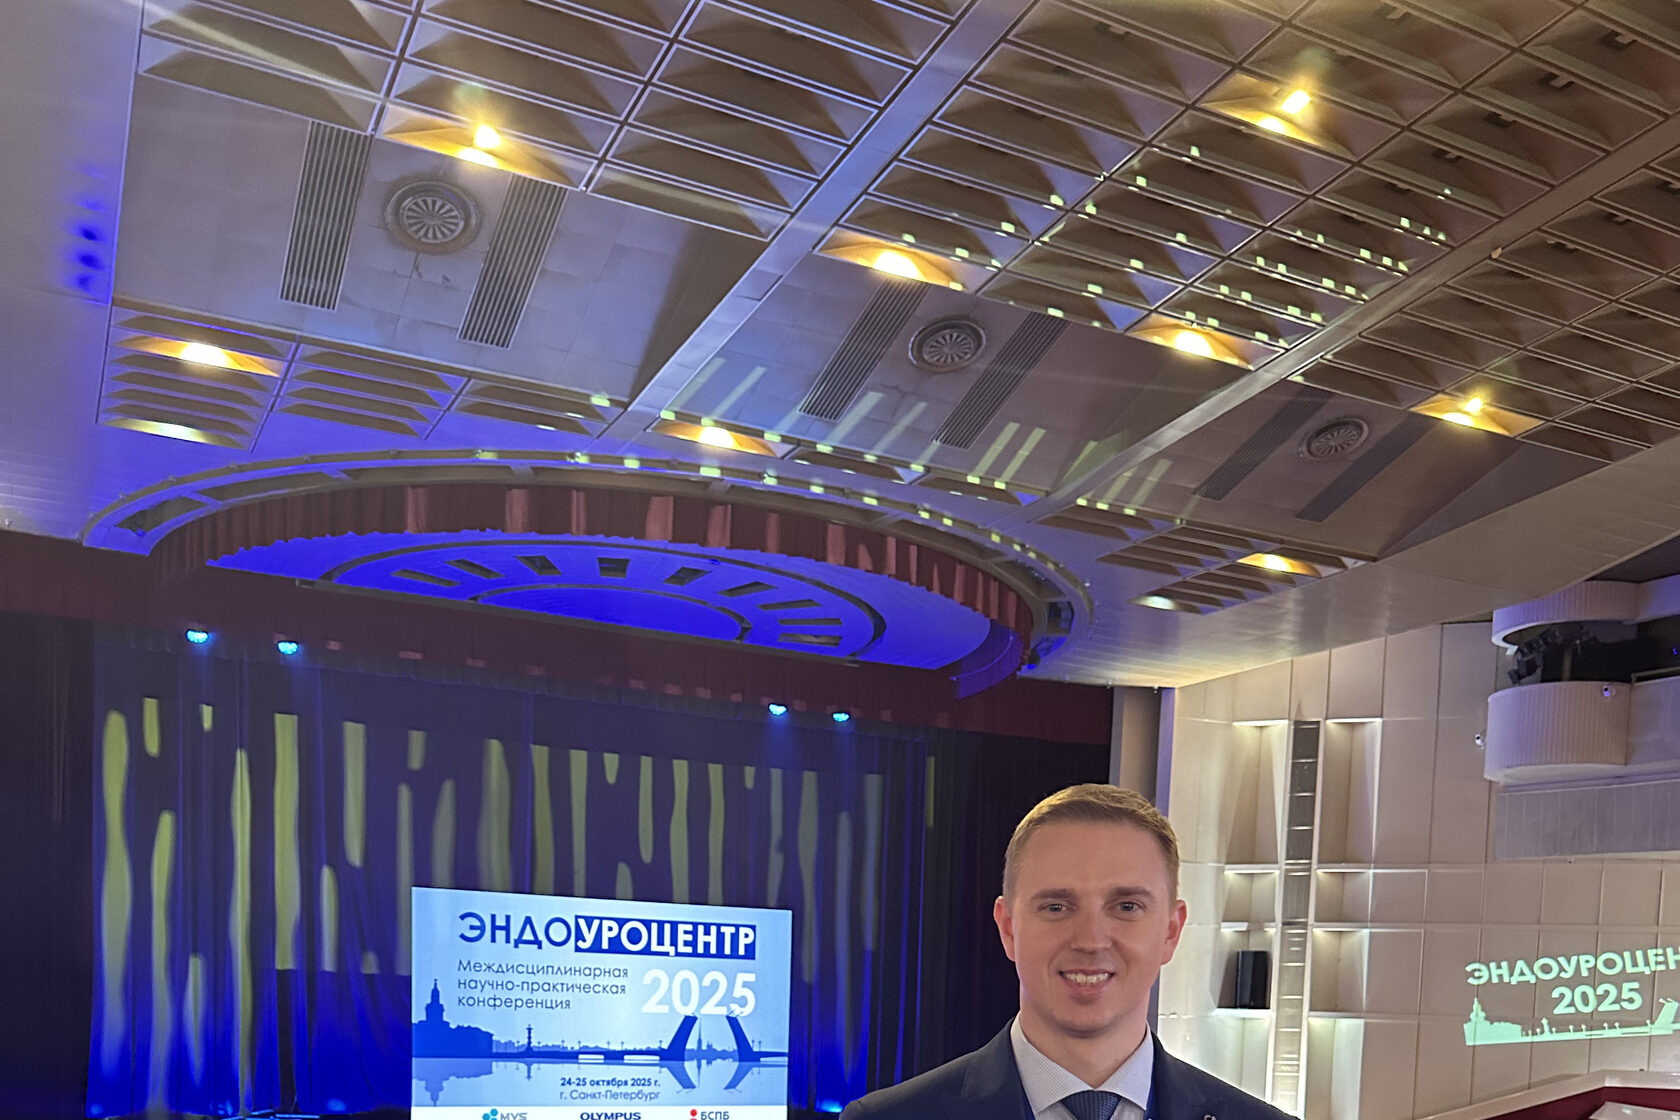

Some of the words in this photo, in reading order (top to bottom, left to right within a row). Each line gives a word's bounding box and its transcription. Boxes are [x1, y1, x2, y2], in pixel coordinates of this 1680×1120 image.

[458, 911, 755, 956] ЭНДОУРОЦЕНТР
[458, 959, 629, 979] Междисциплинарная
[458, 978, 626, 996] научно-практическая
[641, 968, 757, 1017] 2025
[458, 995, 571, 1011] конференция
[1551, 981, 1643, 1015] 2025
[560, 1077, 587, 1087] 24-25
[589, 1078, 629, 1088] октября
[630, 1078, 652, 1087] 2025
[569, 1089, 660, 1102] Санкт-Петербург
[580, 1112, 642, 1120] OLYMPUS
[700, 1111, 730, 1120] БСПБ
